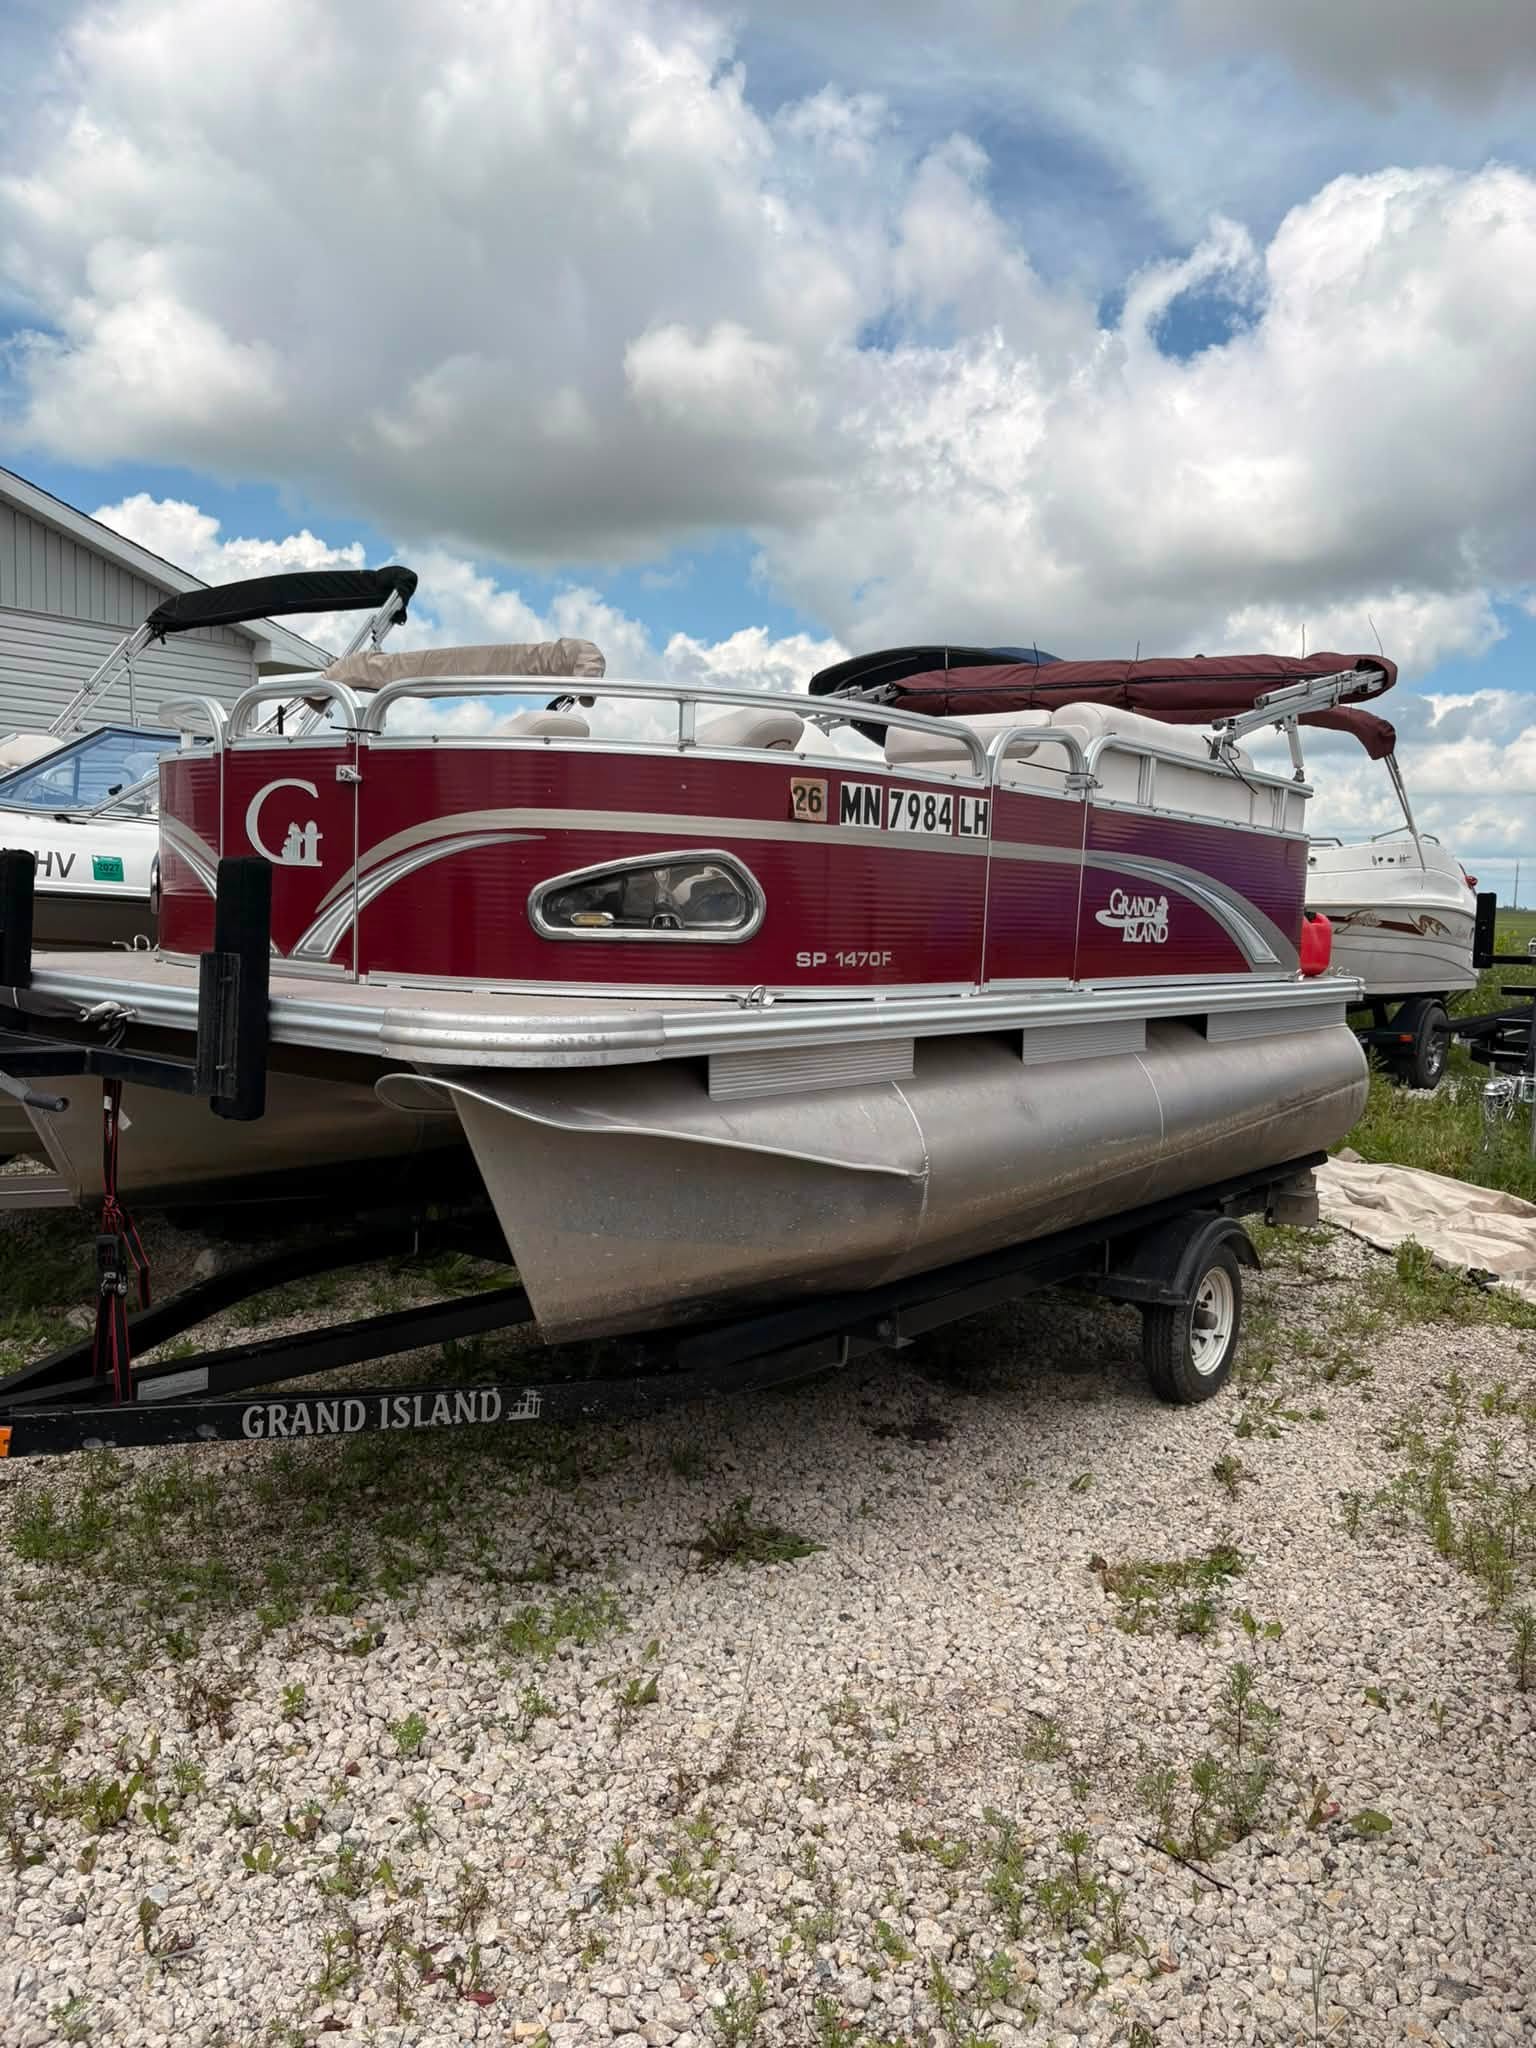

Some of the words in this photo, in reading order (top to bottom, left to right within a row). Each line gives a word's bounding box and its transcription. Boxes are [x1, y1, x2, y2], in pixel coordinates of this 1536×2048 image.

[793, 786, 822, 813] 26
[841, 785, 881, 825] MN
[890, 791, 952, 832] 7984
[960, 798, 988, 835] LH
[34, 850, 76, 878] HV
[1110, 888, 1155, 916] GRAND
[1122, 922, 1169, 943] ISLAND
[796, 952, 827, 967] SP
[835, 951, 892, 967] 1470F
[242, 1400, 366, 1438] GRAND
[379, 1390, 502, 1430] ISLAND
